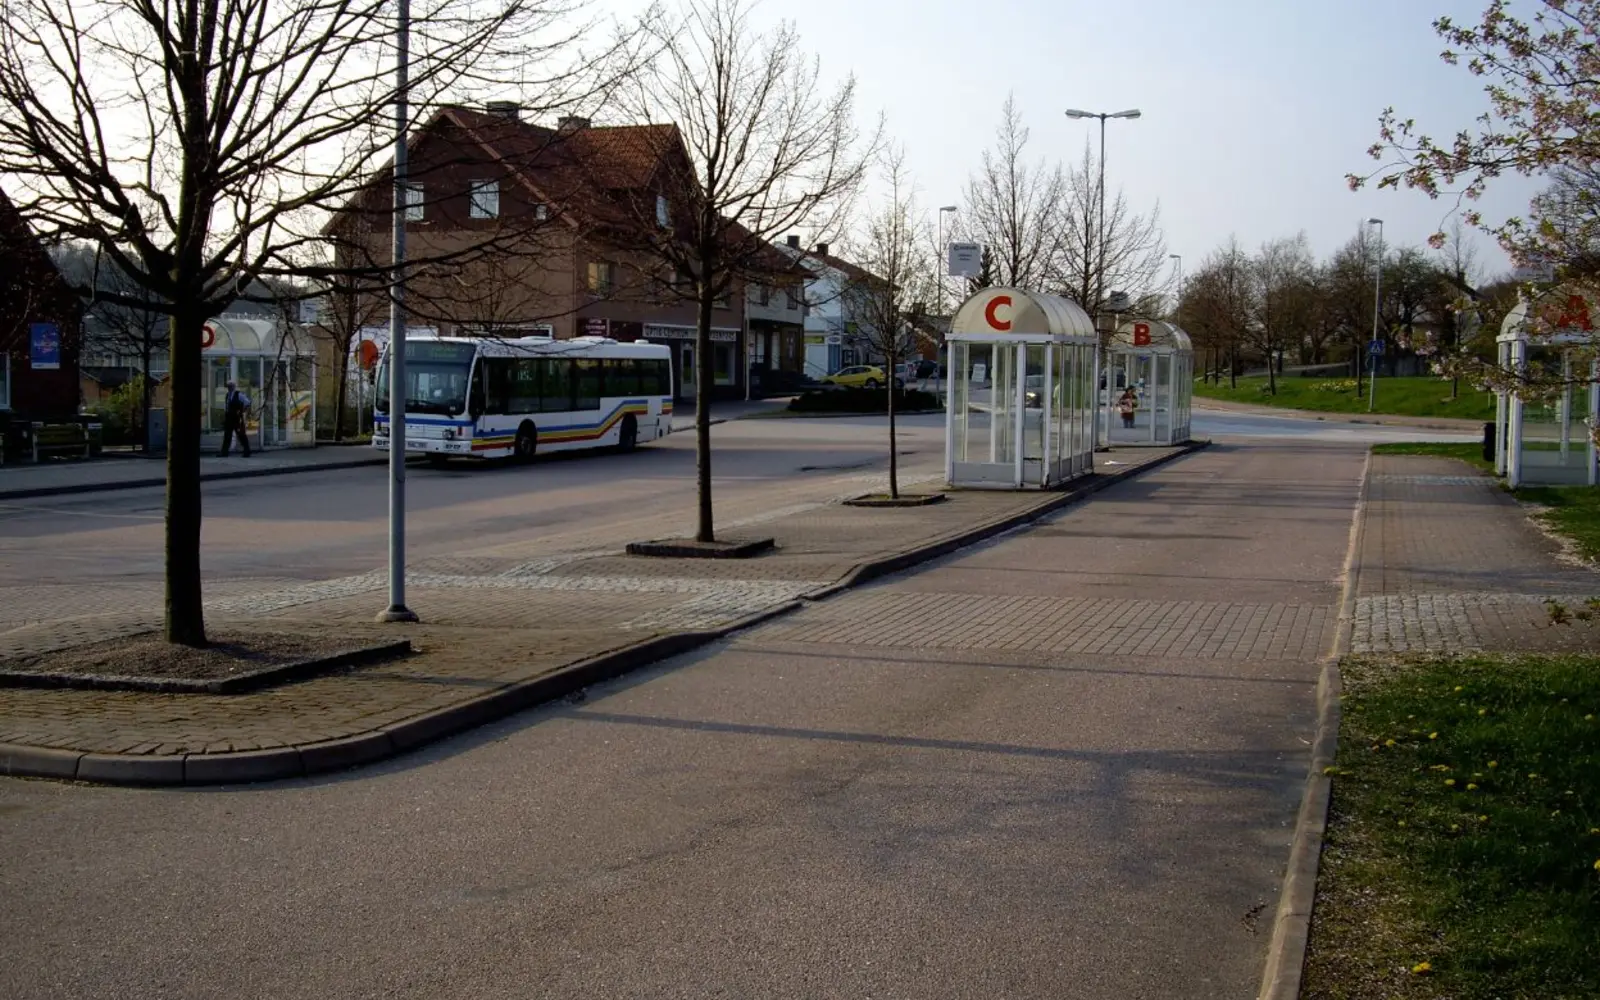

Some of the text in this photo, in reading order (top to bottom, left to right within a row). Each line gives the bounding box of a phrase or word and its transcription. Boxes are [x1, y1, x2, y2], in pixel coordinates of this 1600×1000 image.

[984, 295, 1012, 331] C
[1558, 295, 1593, 331] A
[1134, 323, 1151, 346] B
